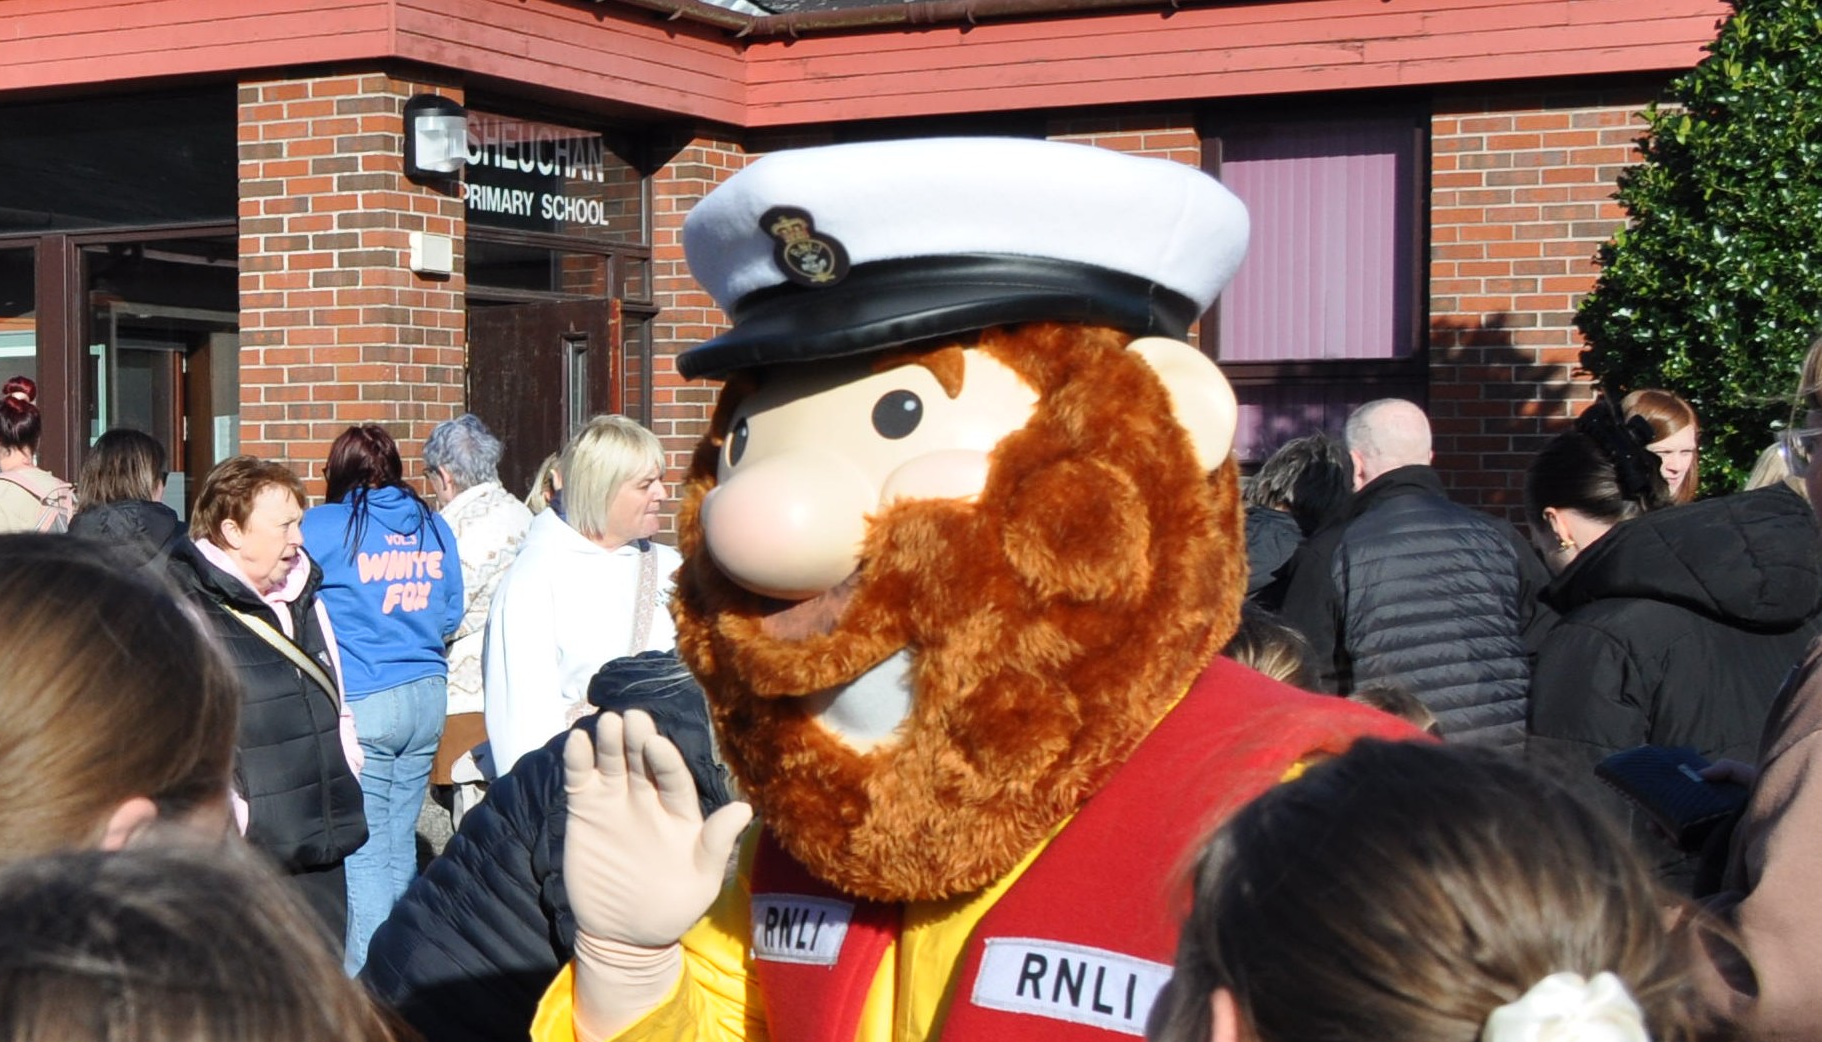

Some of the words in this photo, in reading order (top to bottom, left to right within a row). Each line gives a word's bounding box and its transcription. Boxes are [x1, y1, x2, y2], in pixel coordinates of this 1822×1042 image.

[461, 181, 534, 217] PRIMARY
[541, 193, 609, 226] SCHOOL
[358, 550, 444, 584] WHITE
[382, 581, 432, 615] FOX
[764, 906, 827, 951] RNLI
[1016, 952, 1137, 1020] RNLI
